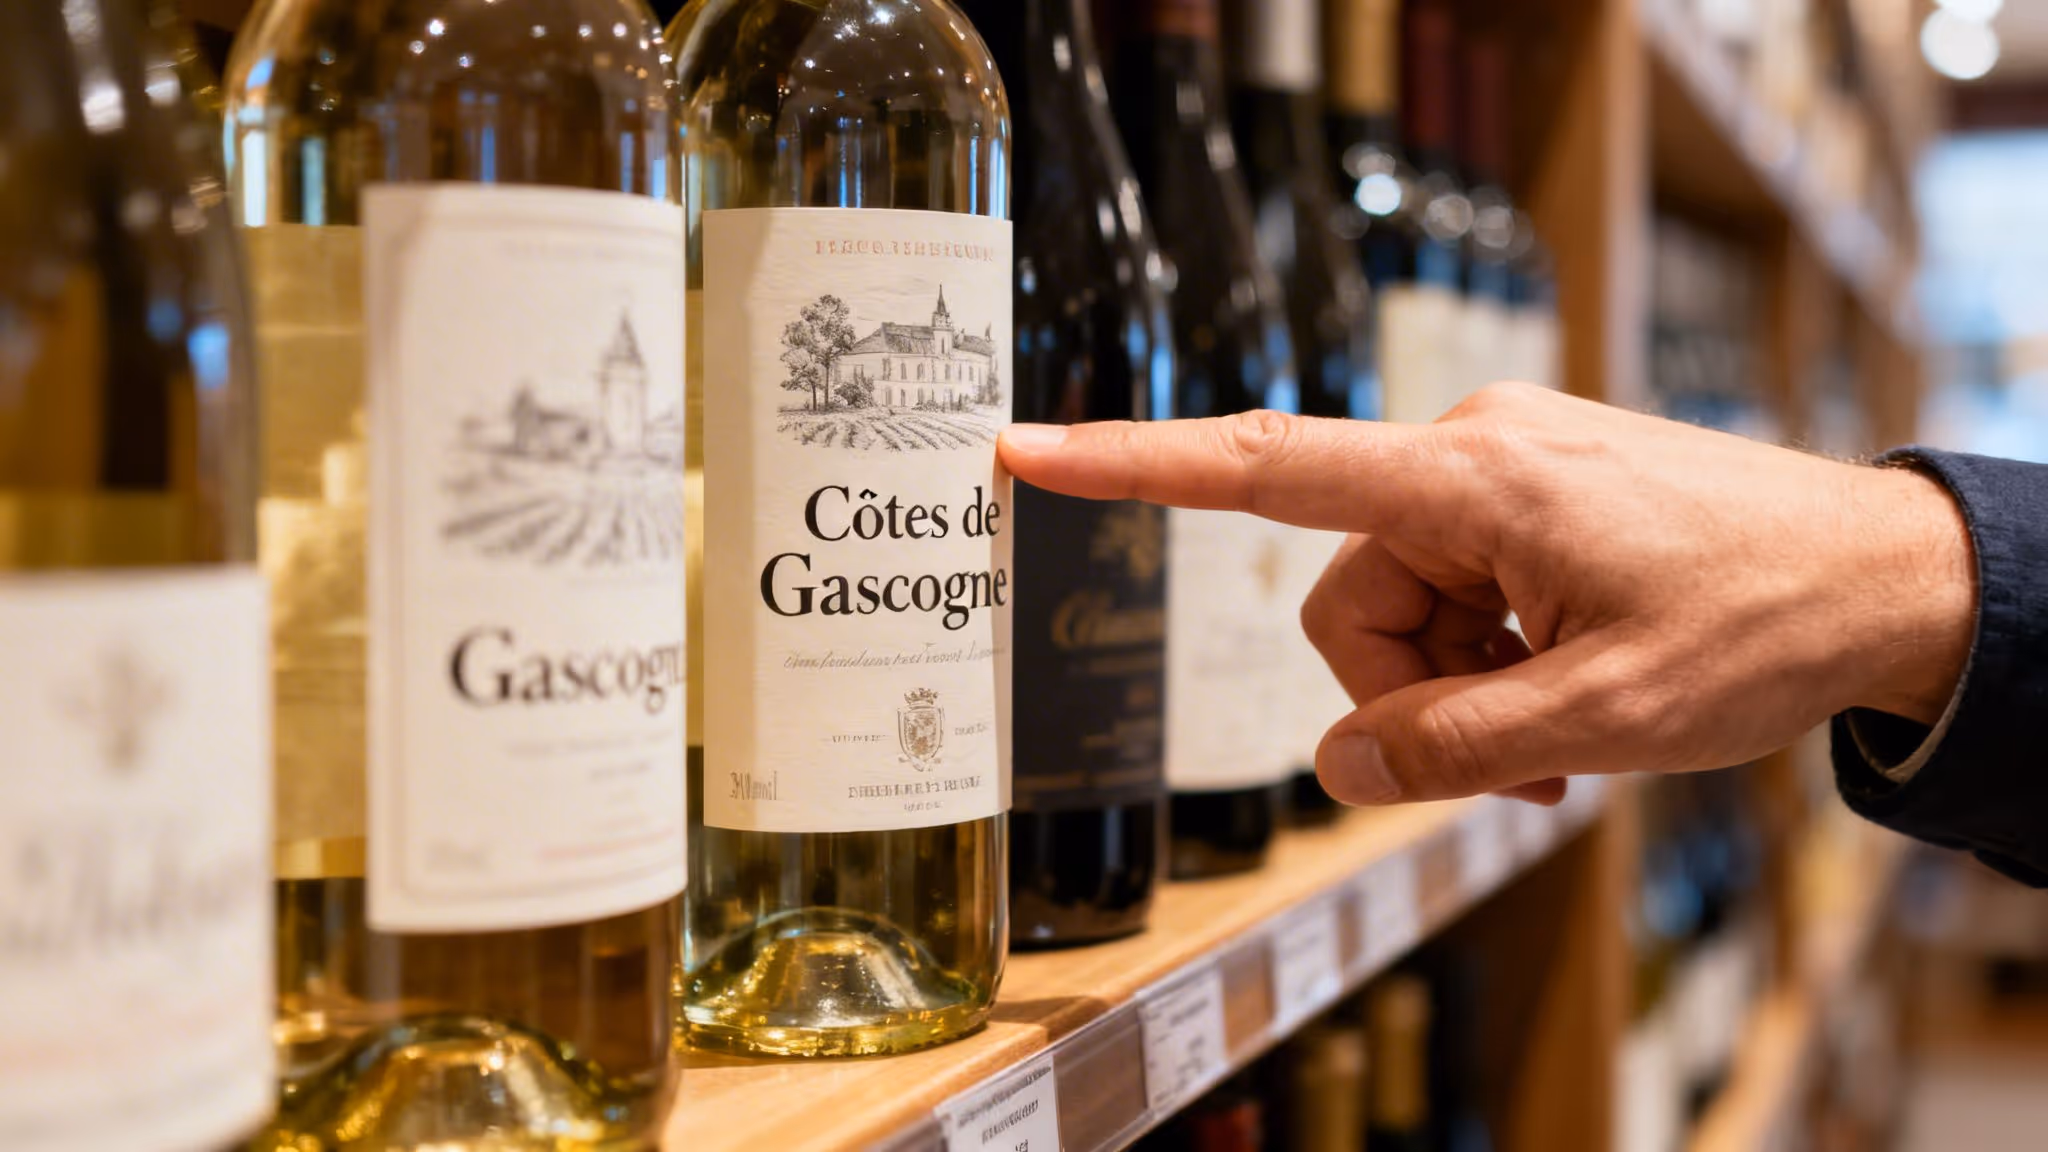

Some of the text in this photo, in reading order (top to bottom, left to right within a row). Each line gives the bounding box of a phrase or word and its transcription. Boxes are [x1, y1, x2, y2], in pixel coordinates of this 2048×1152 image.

[805, 485, 1001, 542] Côtes de
[760, 552, 1008, 631] Gascogne
